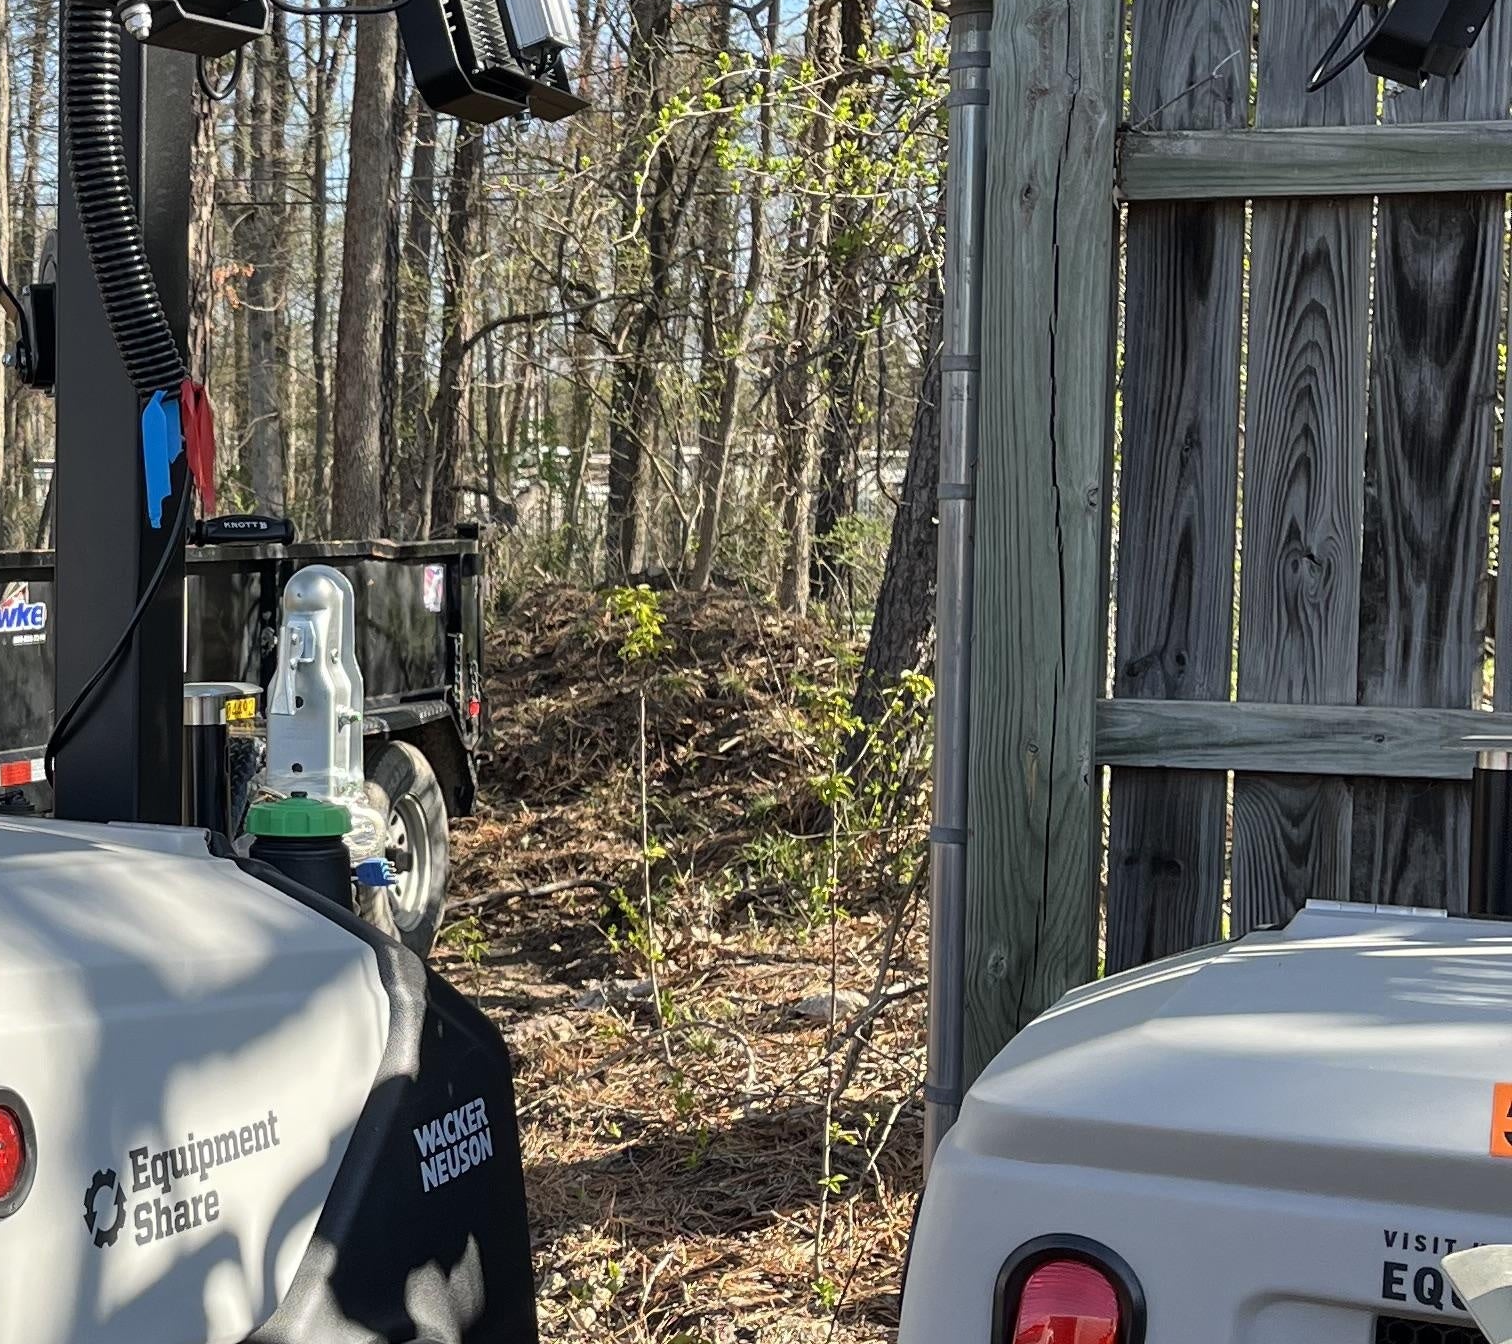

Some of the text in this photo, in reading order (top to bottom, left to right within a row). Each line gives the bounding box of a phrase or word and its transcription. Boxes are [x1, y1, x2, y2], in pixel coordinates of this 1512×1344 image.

[129, 1110, 281, 1194] Equipment
[413, 1097, 489, 1157] WACKER
[420, 1127, 493, 1193] NEUSON
[133, 1189, 220, 1246] Share
[1384, 1229, 1457, 1255] VISIT
